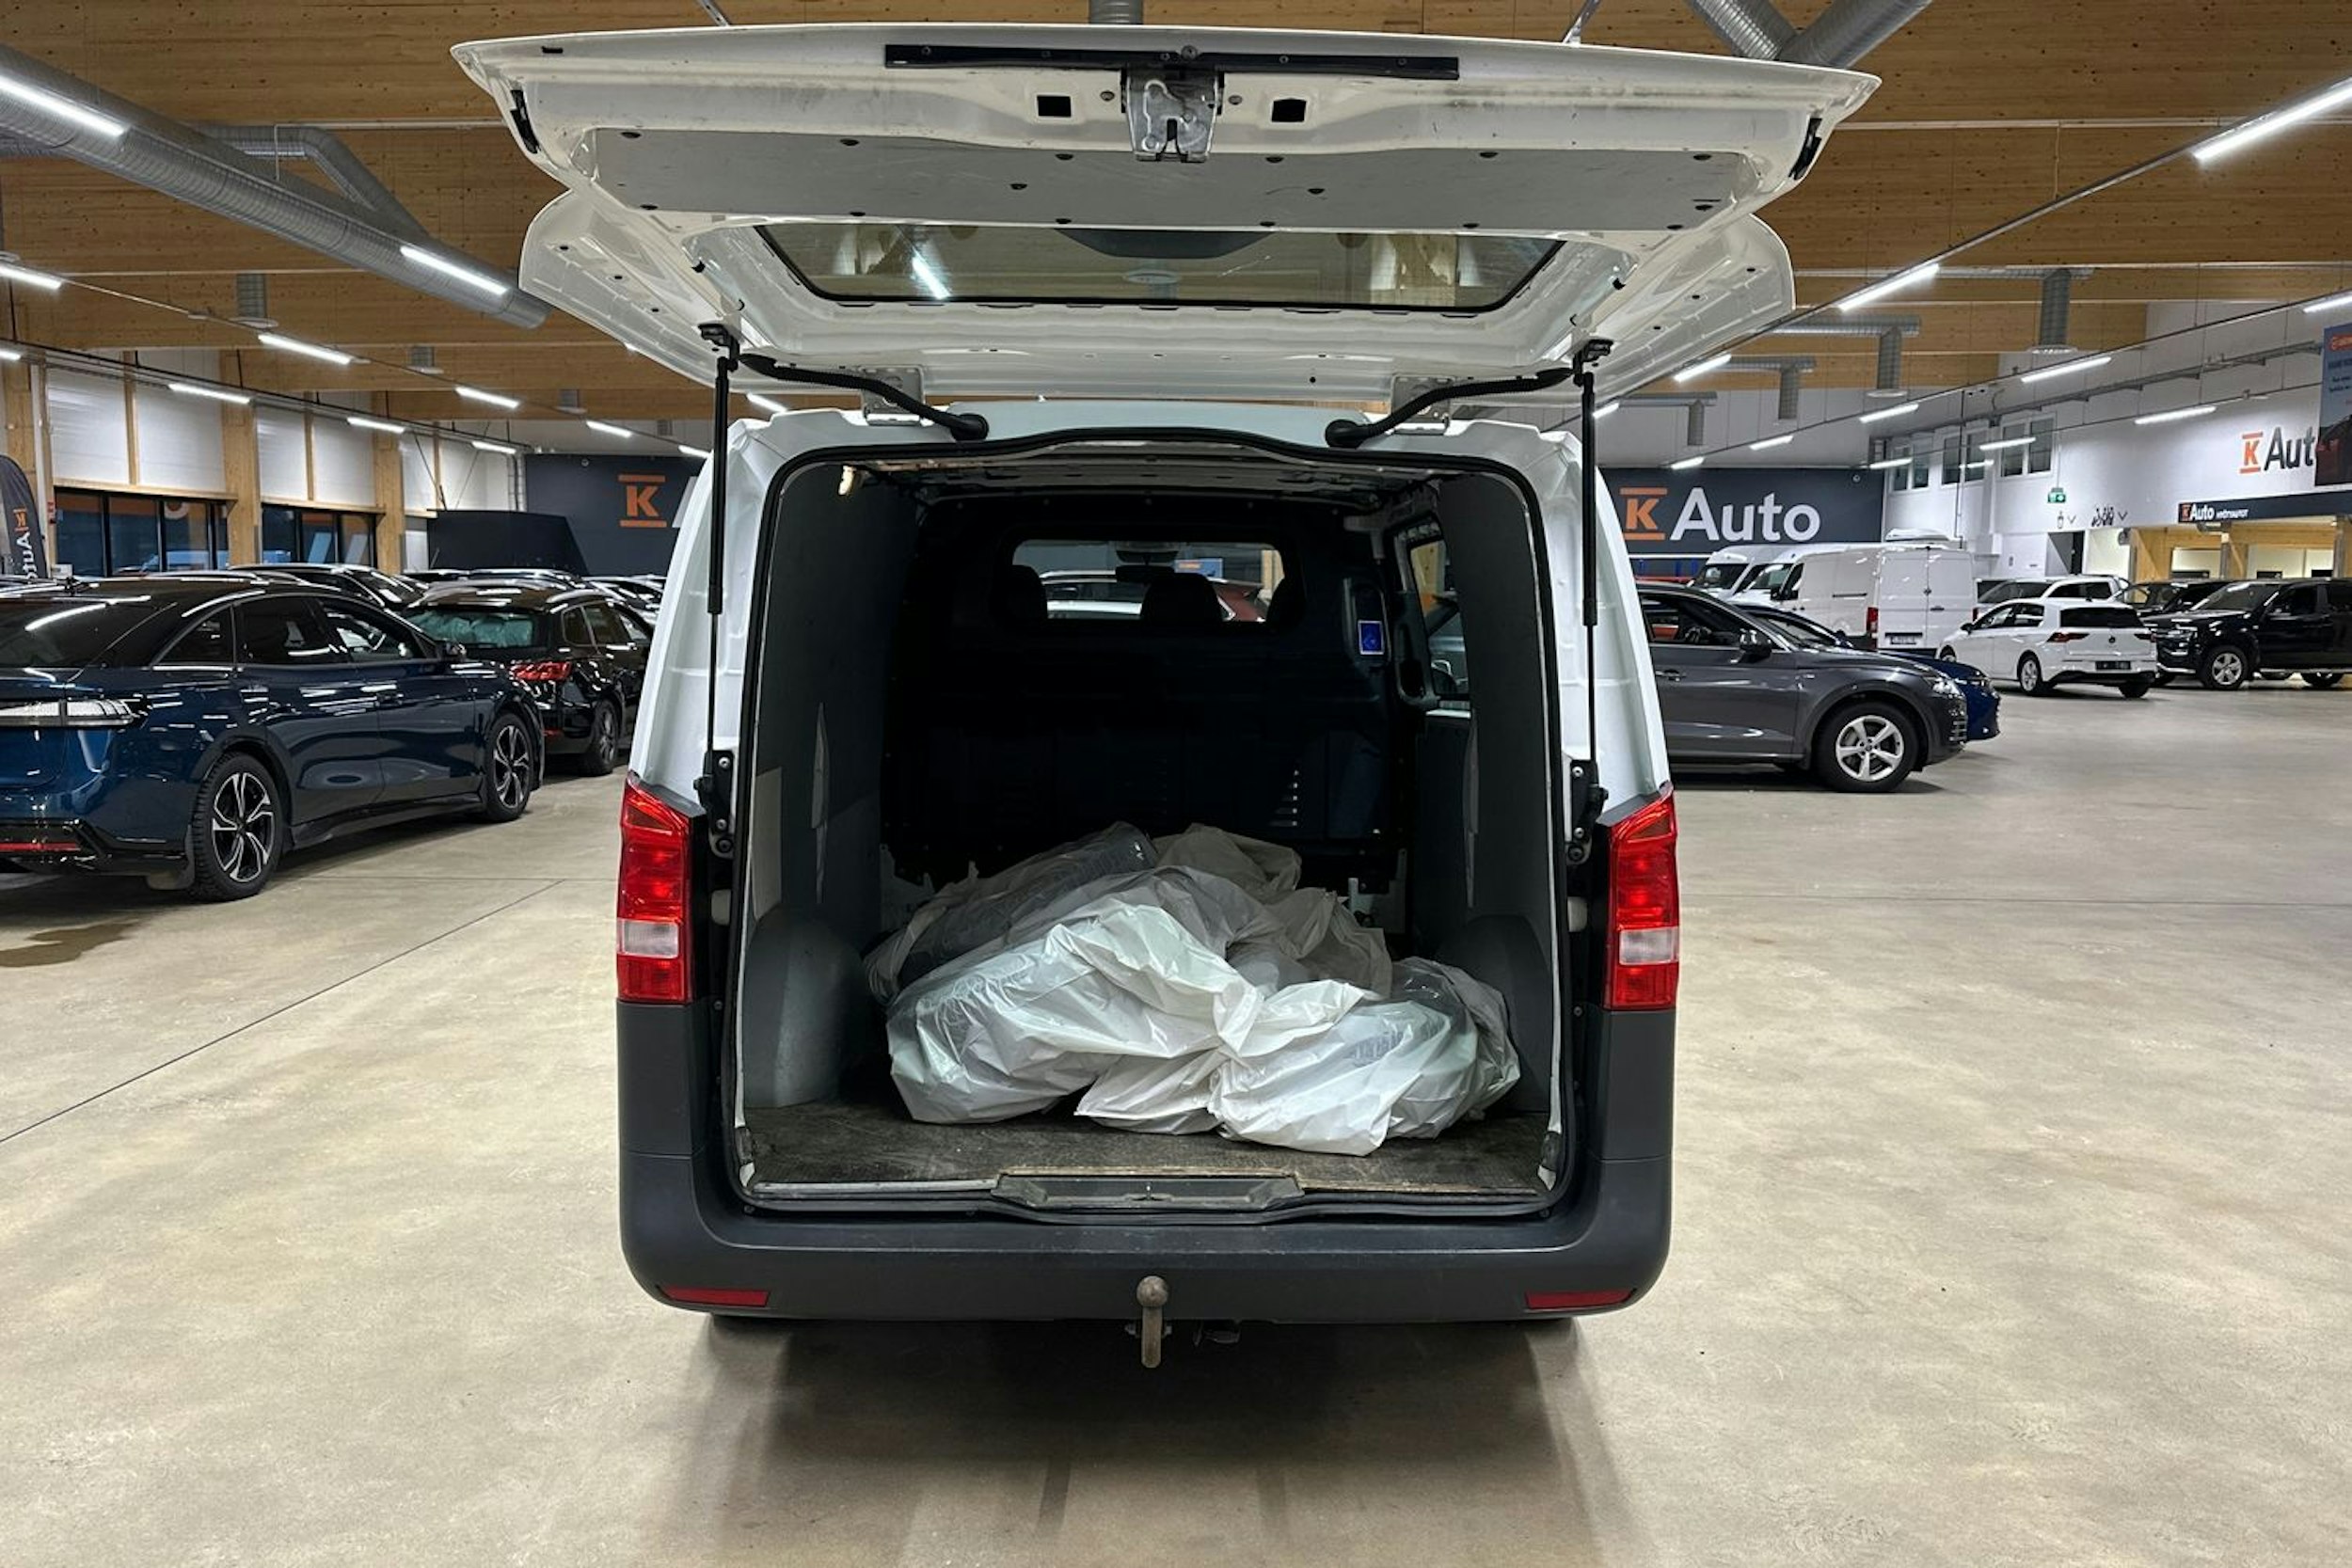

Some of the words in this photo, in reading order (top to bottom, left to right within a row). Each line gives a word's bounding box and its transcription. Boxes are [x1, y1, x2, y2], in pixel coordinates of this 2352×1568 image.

[2264, 426, 2315, 470] Aut
[1669, 486, 1820, 542] Auto
[2190, 503, 2215, 521] Auto
